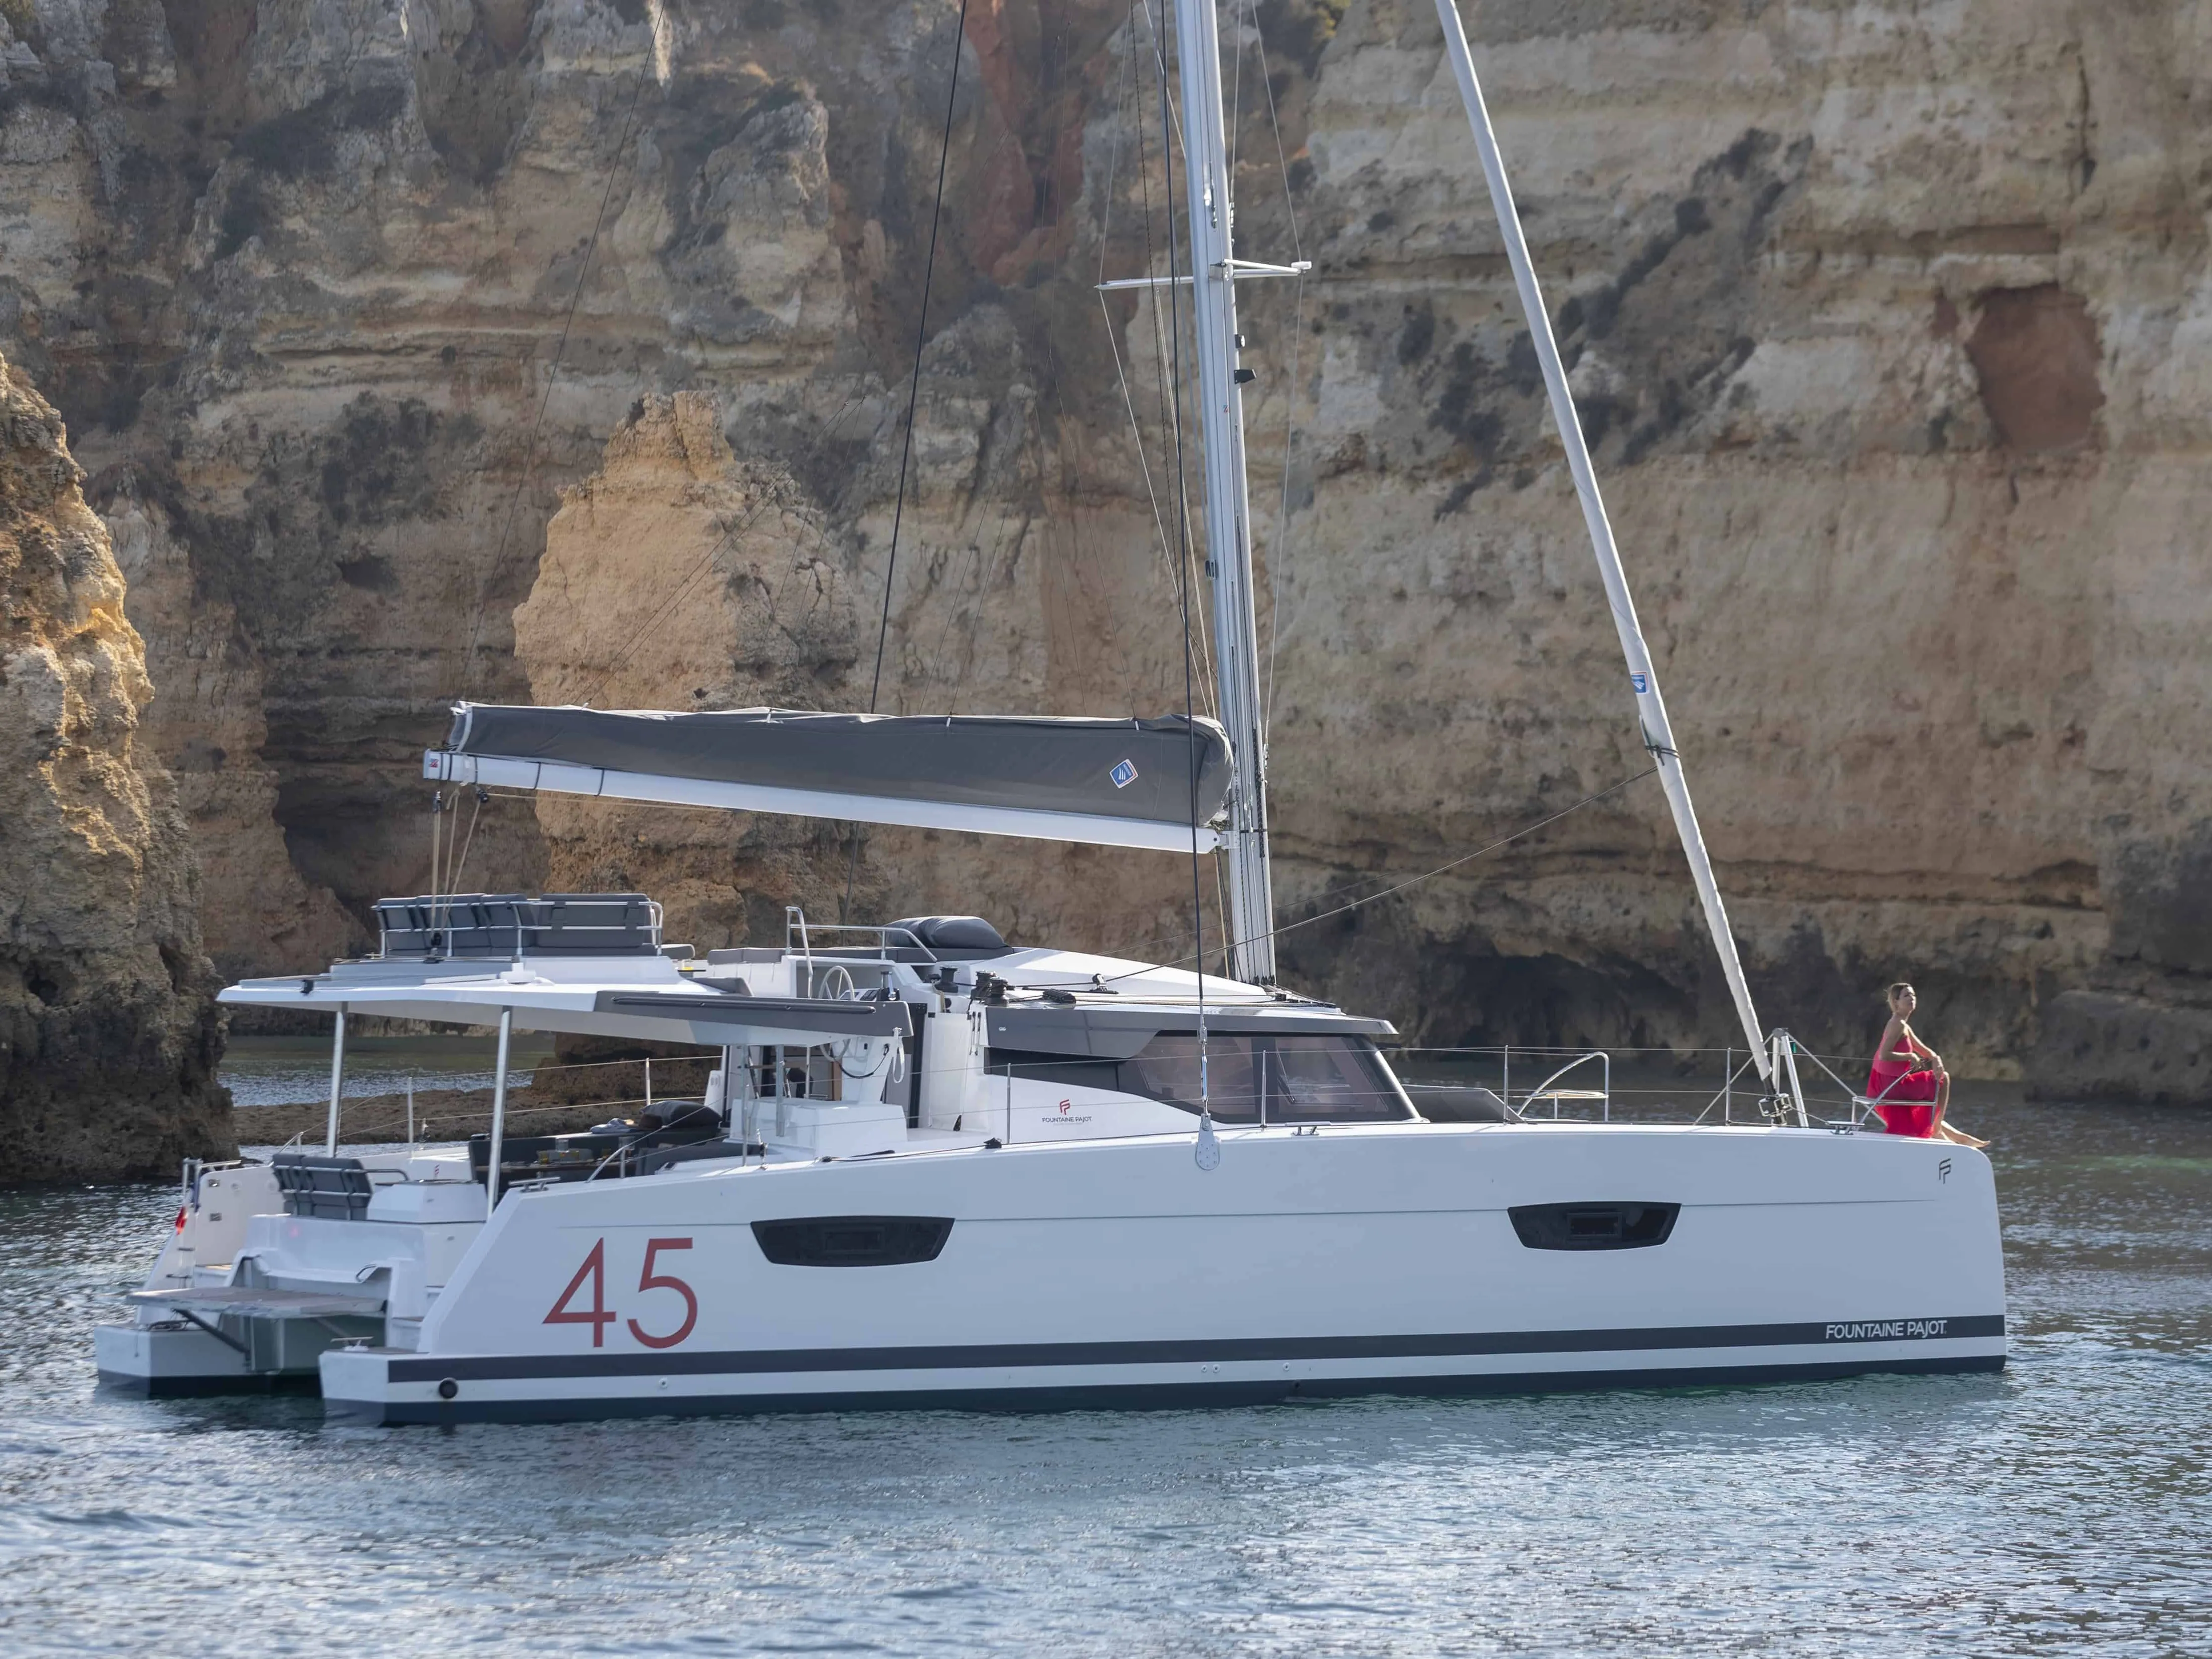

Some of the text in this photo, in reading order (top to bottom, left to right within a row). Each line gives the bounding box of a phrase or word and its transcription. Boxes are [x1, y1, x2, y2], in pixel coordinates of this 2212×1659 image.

[542, 1237, 697, 1348] 45
[1825, 1320, 1947, 1339] FOUNTAINE PAJOT
